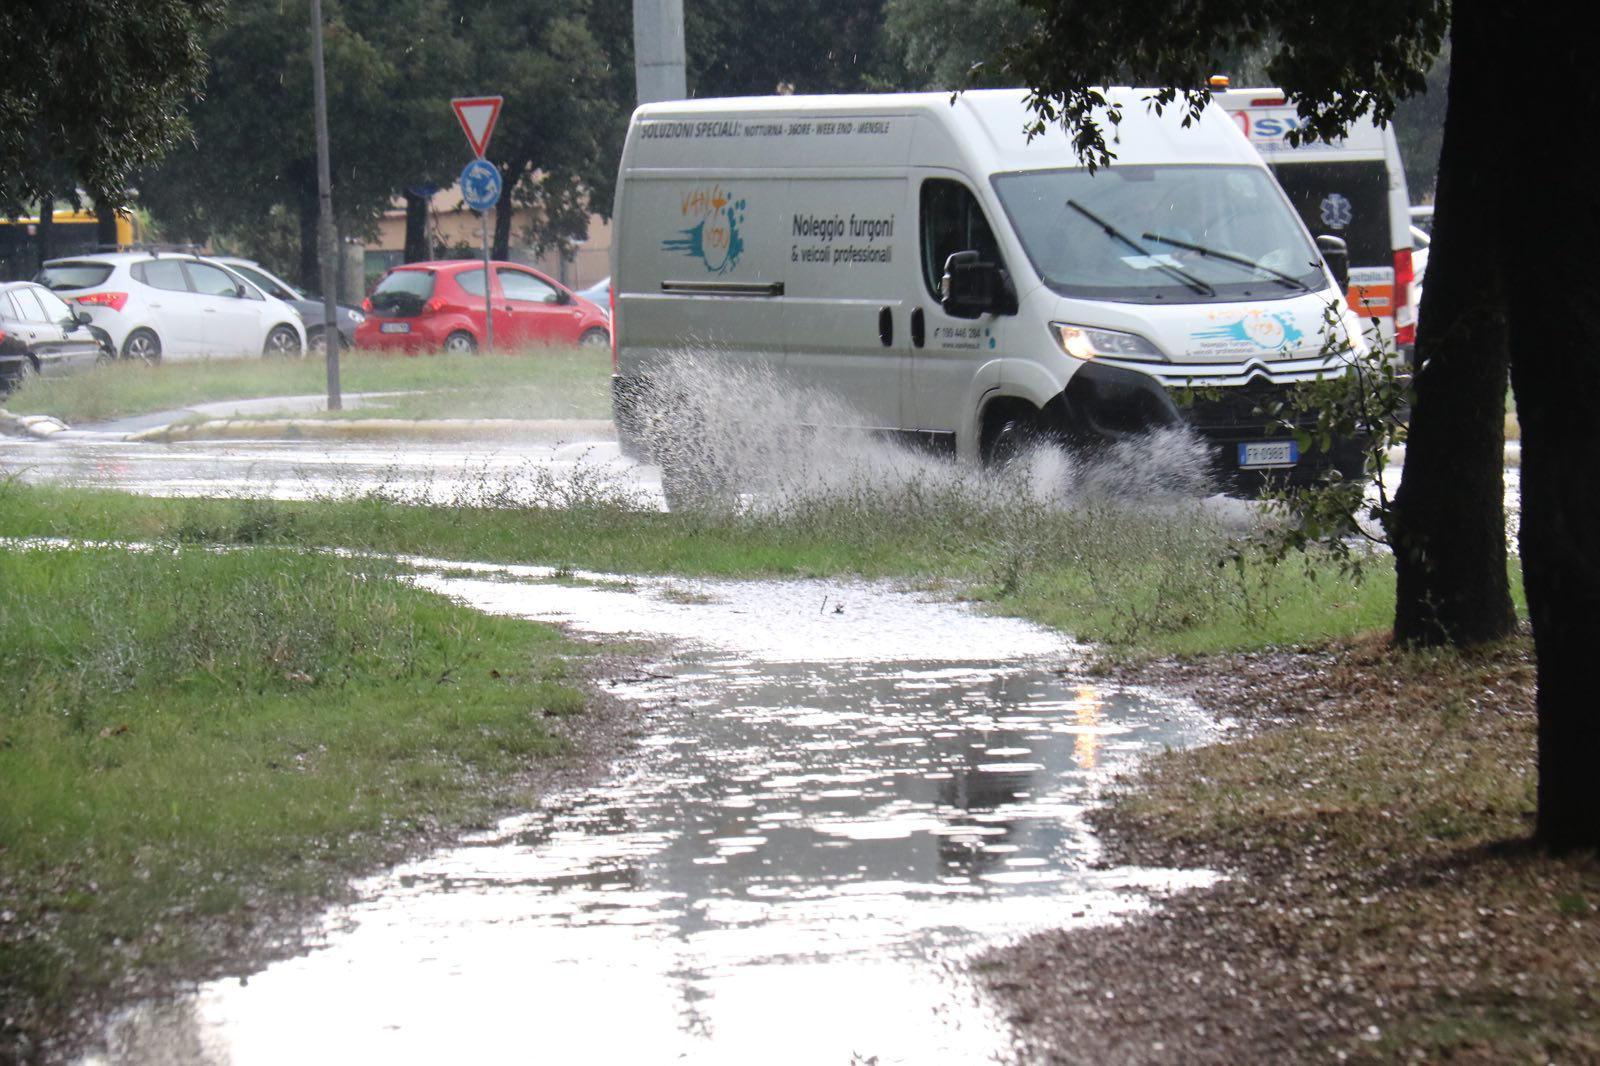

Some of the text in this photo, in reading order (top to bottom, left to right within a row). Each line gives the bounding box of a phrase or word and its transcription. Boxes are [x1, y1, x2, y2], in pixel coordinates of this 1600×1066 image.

[641, 122, 693, 139] SOLUZIONI
[695, 121, 742, 138] SPECIALI:
[744, 124, 783, 136] NOTTURNA
[815, 122, 836, 135] WEEK
[836, 122, 853, 135] END
[857, 121, 890, 134] MENSILE
[792, 213, 895, 242] Noleggio furgoni
[791, 244, 892, 265] & veicoli professionali
